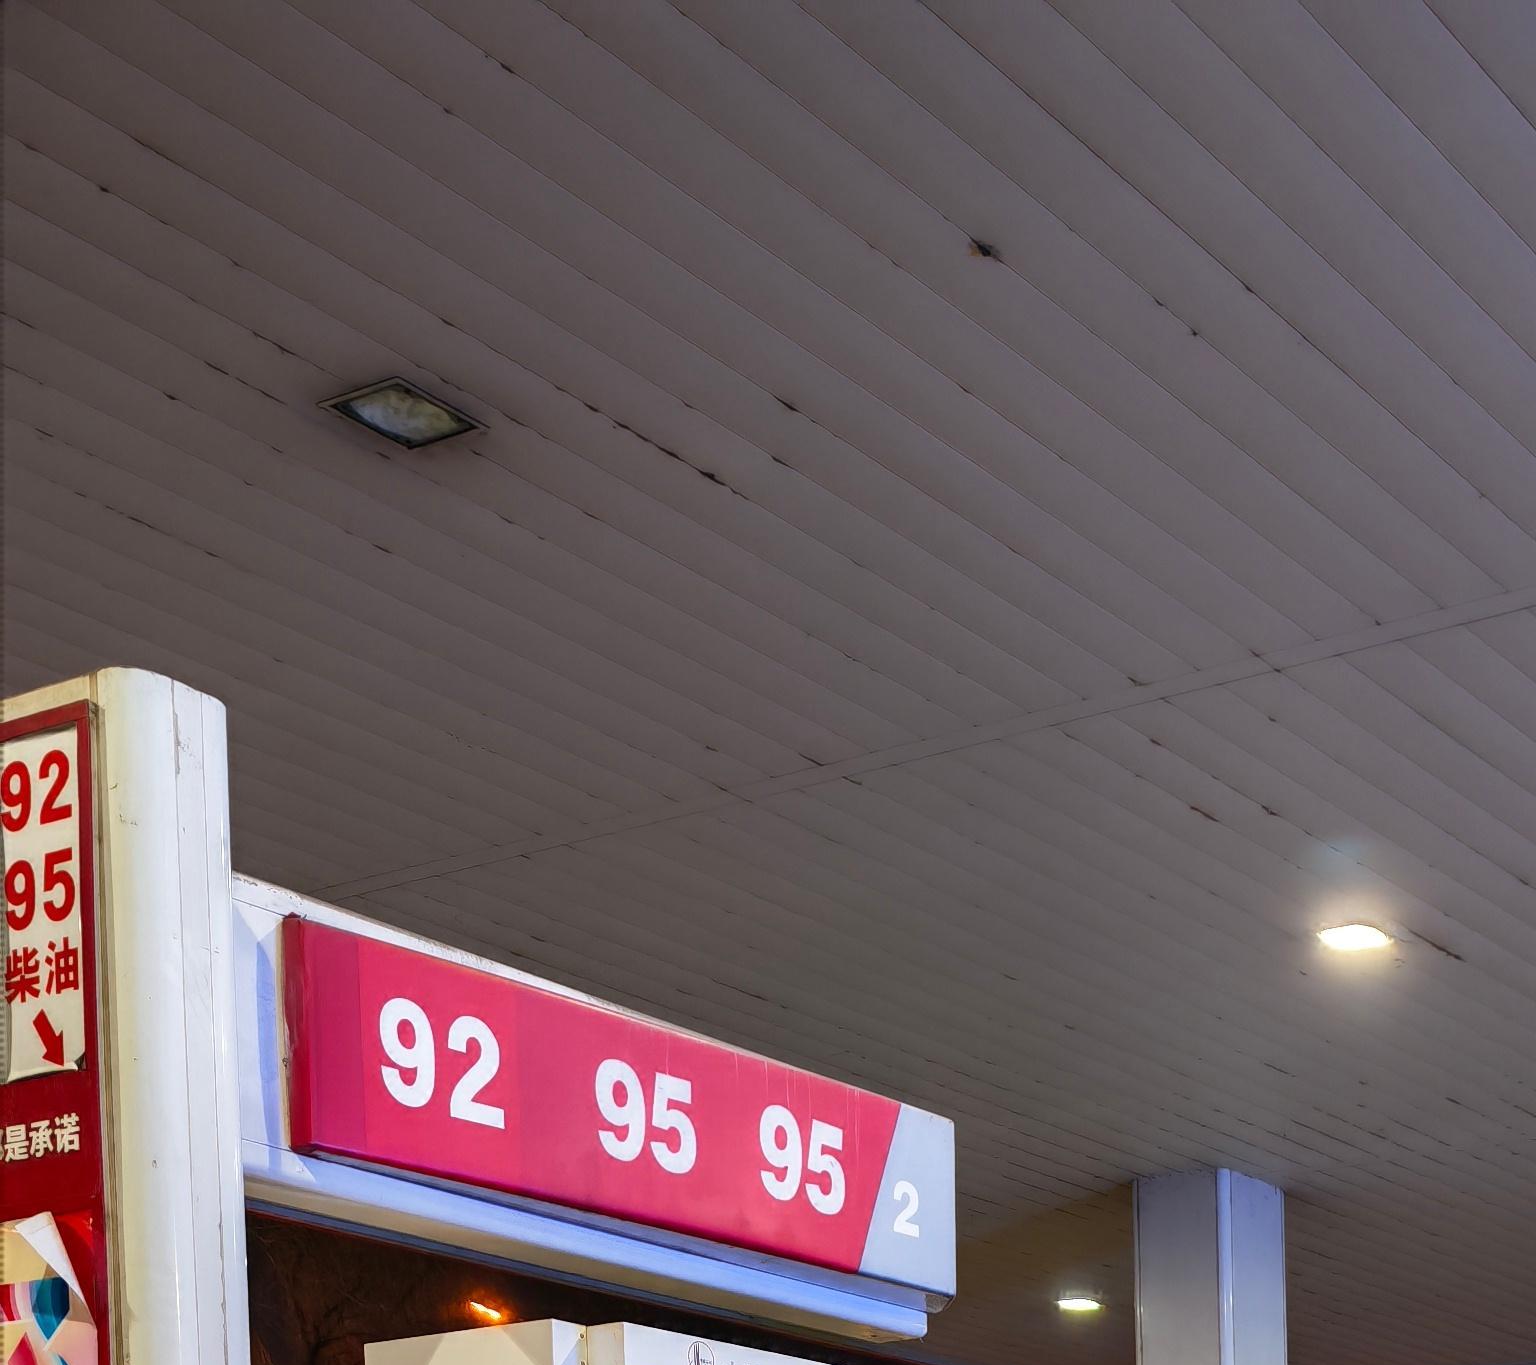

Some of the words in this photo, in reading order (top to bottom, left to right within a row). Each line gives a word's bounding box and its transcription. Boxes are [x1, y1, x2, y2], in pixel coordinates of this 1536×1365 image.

[1, 749, 73, 833] 92
[3, 848, 77, 933] 95
[4, 936, 80, 1004] 柴油
[0, 1112, 80, 1162] 是承诺
[379, 997, 506, 1130] 92
[595, 1058, 696, 1175] 95
[758, 1104, 847, 1216] 95
[892, 1180, 920, 1238] 2
